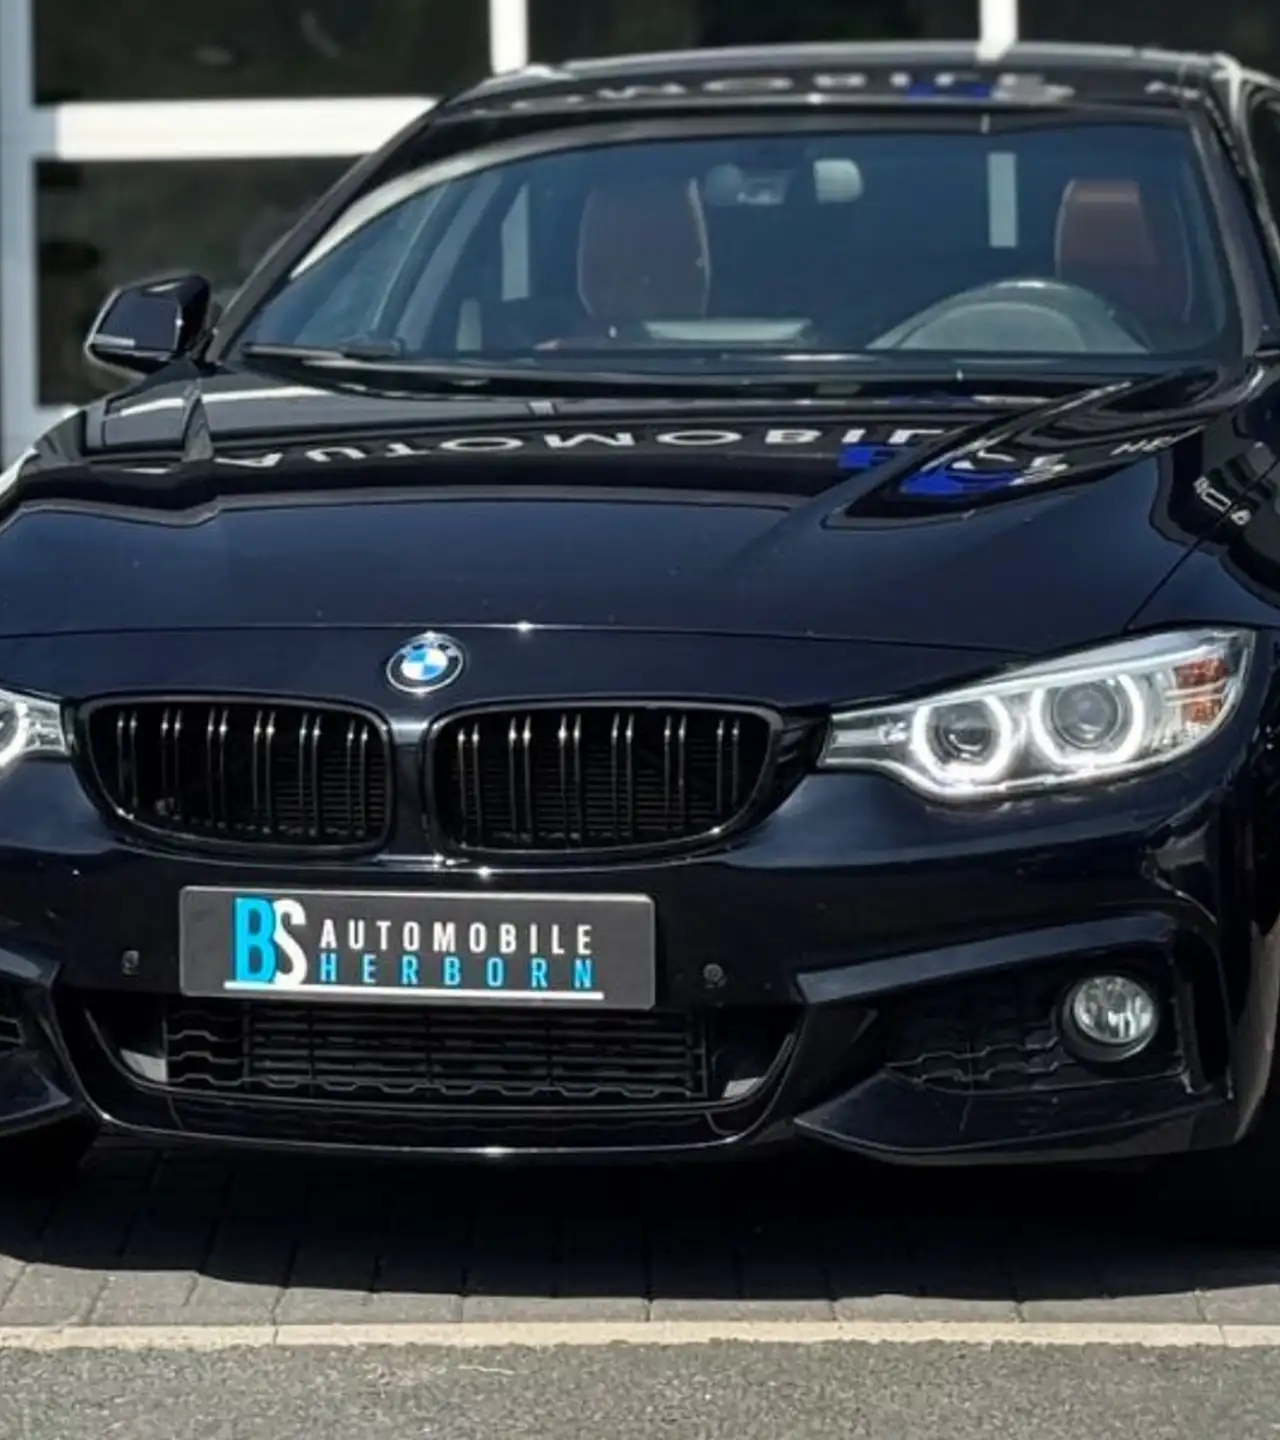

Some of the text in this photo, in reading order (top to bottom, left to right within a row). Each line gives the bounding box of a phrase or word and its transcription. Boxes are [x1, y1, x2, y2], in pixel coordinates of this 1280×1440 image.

[234, 897, 308, 987] BS
[319, 918, 593, 955] AUTOMOBILE
[319, 953, 593, 989] HERBORN
